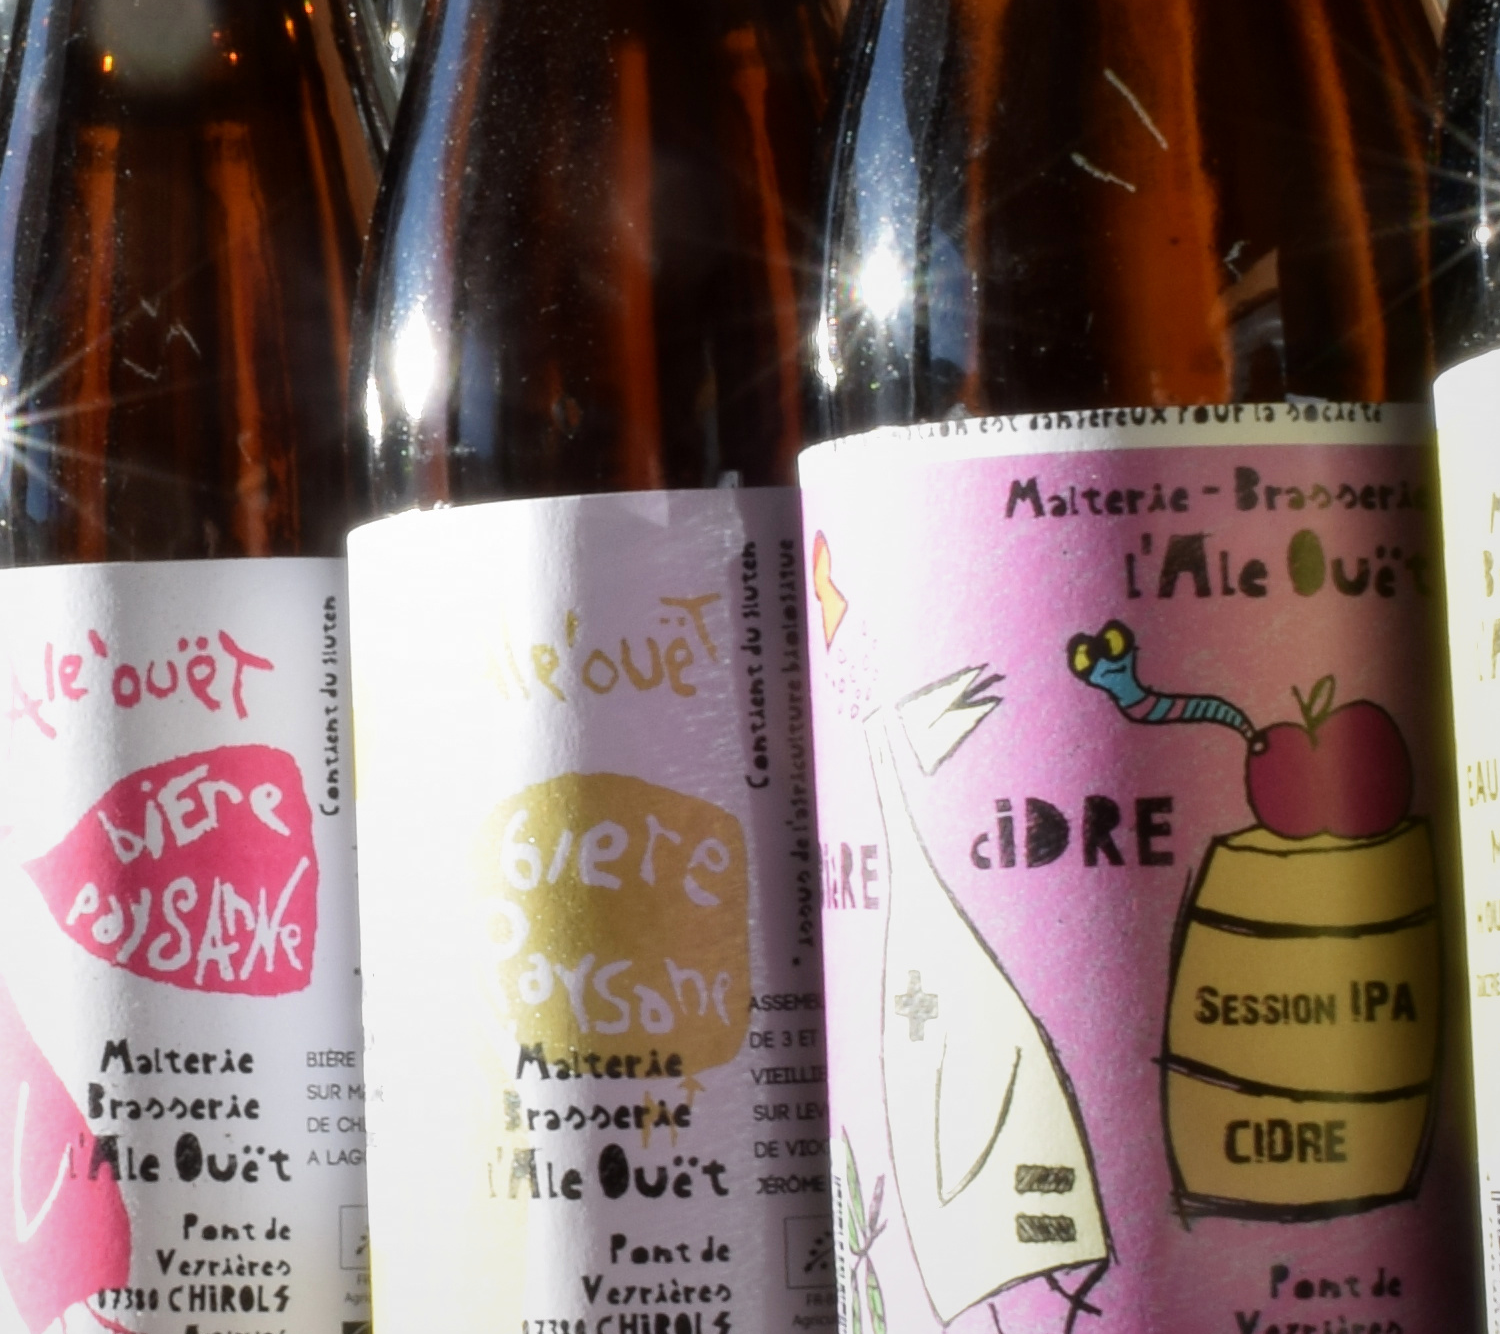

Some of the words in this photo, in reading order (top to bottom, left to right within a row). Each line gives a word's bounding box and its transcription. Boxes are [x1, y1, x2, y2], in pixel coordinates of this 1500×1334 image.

[1004, 475, 1190, 520] Malterie
[1124, 531, 1270, 600] l'Ale
[1286, 528, 1433, 599] Ouët
[323, 595, 337, 664] gluten
[319, 672, 338, 699] du
[742, 665, 769, 789] Contient
[319, 705, 339, 817] Contient
[1350, 978, 1418, 1024] IPA
[100, 1038, 254, 1075] Malterie
[750, 1031, 774, 1048] DE
[782, 1031, 792, 1047] 3
[800, 1030, 817, 1047] ET
[307, 1049, 356, 1067] BIÈRE
[515, 1043, 684, 1082] Malterie
[87, 1082, 260, 1120] Brasserie
[307, 1084, 341, 1101] SUR
[69, 1133, 159, 1183] l'Ale
[175, 1132, 291, 1183] Ouët
[1223, 1119, 1348, 1164] CIDRE
[487, 1146, 584, 1199] l'Ale
[599, 1144, 729, 1199] Ouët
[184, 1213, 256, 1240] Pont
[264, 1213, 290, 1240] de
[157, 1249, 291, 1277] Veyrières
[610, 1233, 692, 1264] Pont
[701, 1235, 731, 1264] de
[99, 1287, 159, 1311] 07380
[581, 1274, 732, 1305] Veyrières
[1271, 1264, 1360, 1300] Pont
[1371, 1268, 1402, 1298] de
